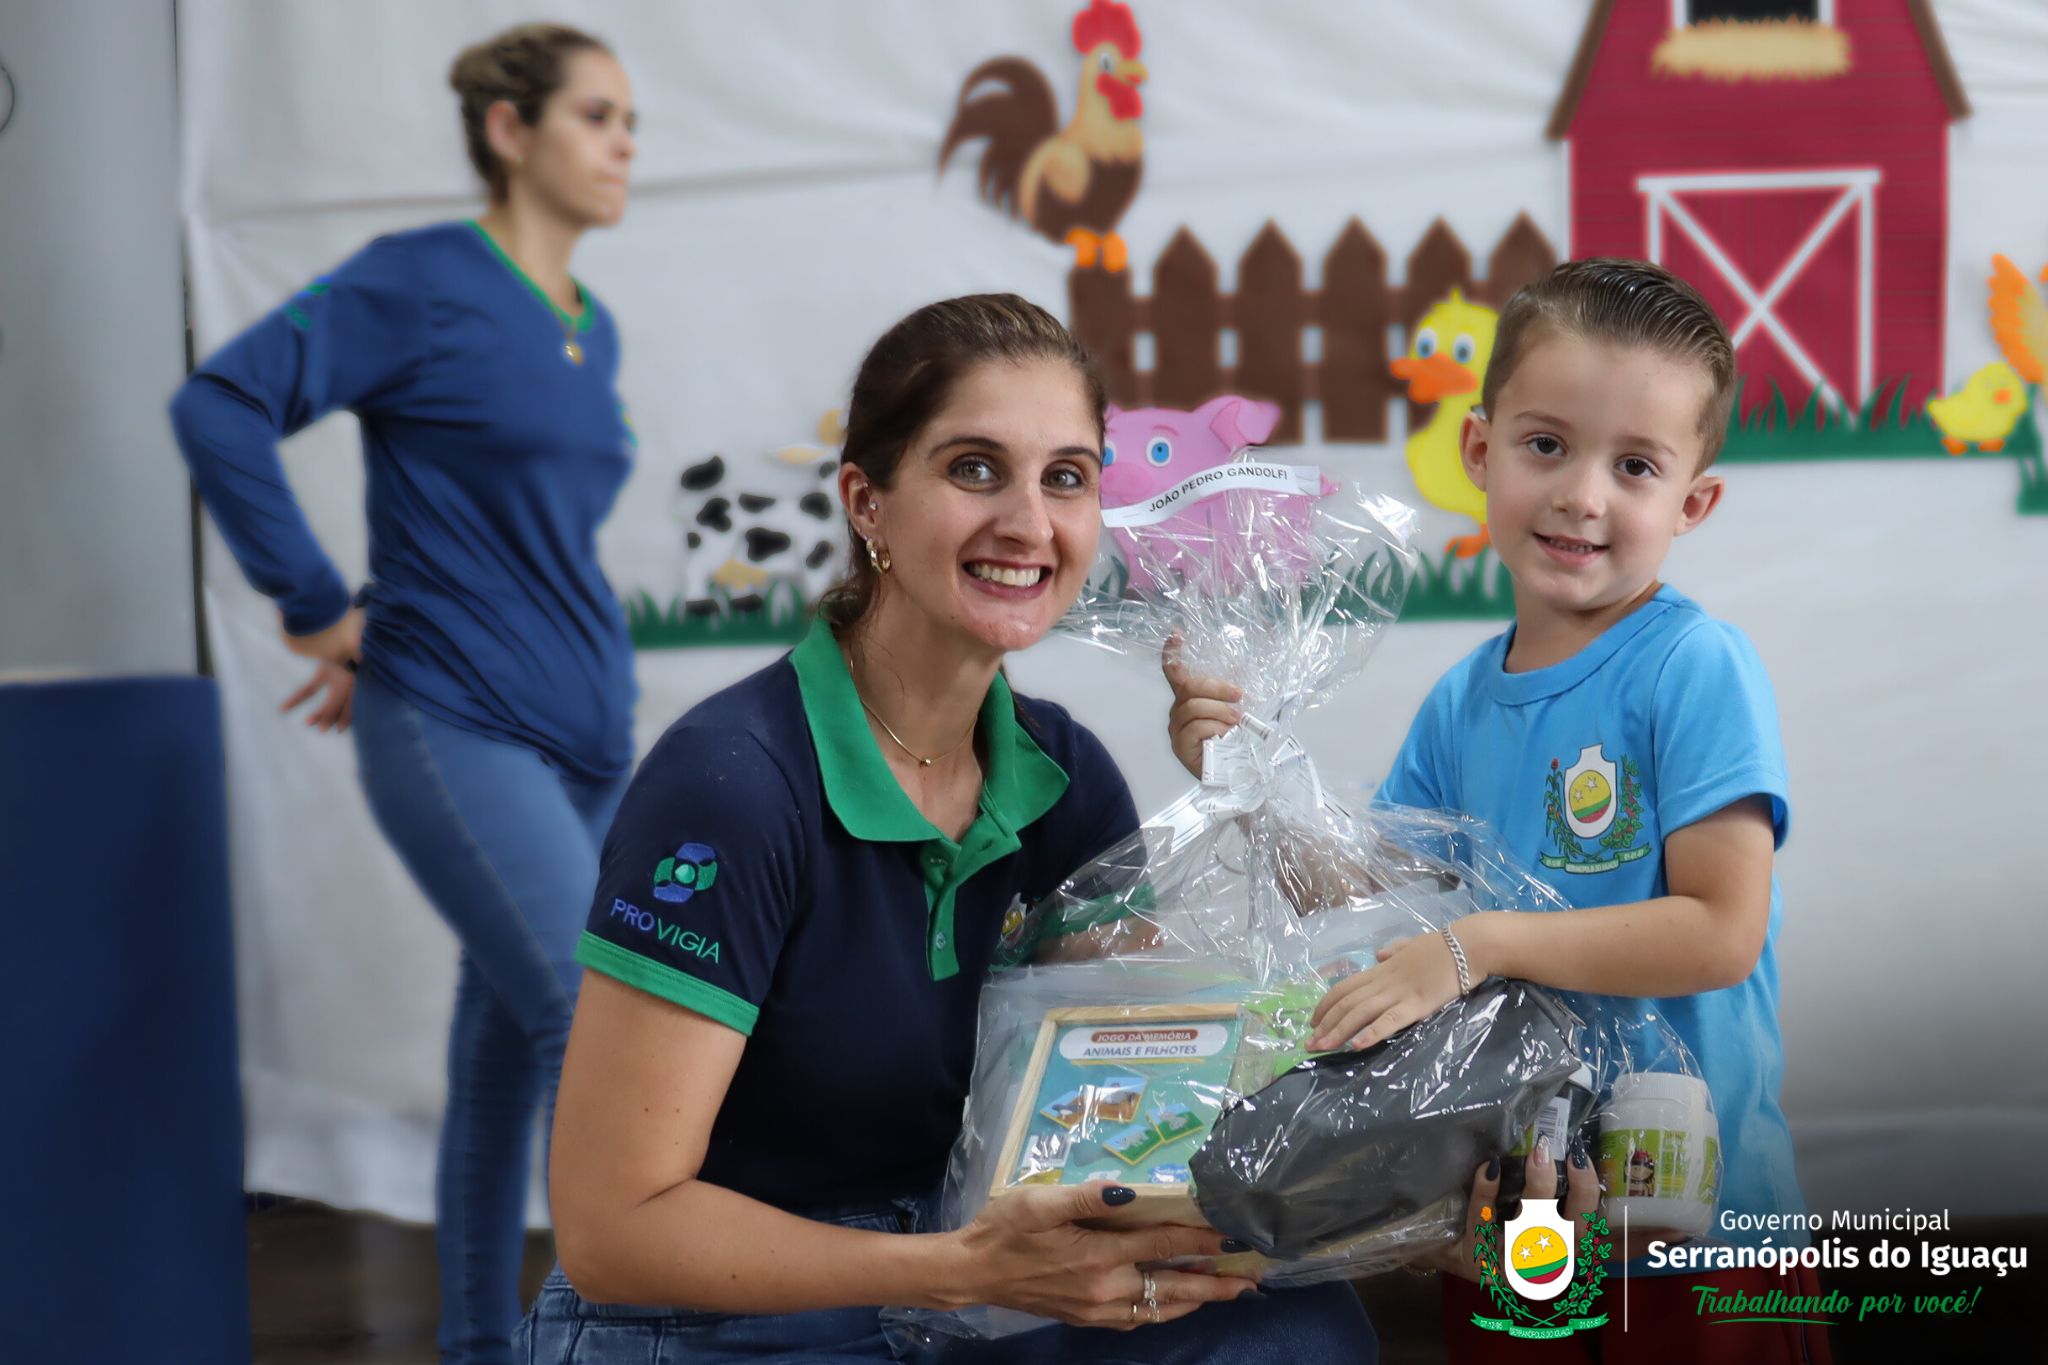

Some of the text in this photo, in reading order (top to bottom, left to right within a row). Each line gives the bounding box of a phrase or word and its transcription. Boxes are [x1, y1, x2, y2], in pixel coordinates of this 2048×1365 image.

[1149, 466, 1288, 512] JOÃO PEDRO GANDOLFI
[1097, 1030, 1192, 1042] JOGO DA MEMÓRIA
[1083, 1044, 1198, 1057] ANIMAIS E FILHOTES
